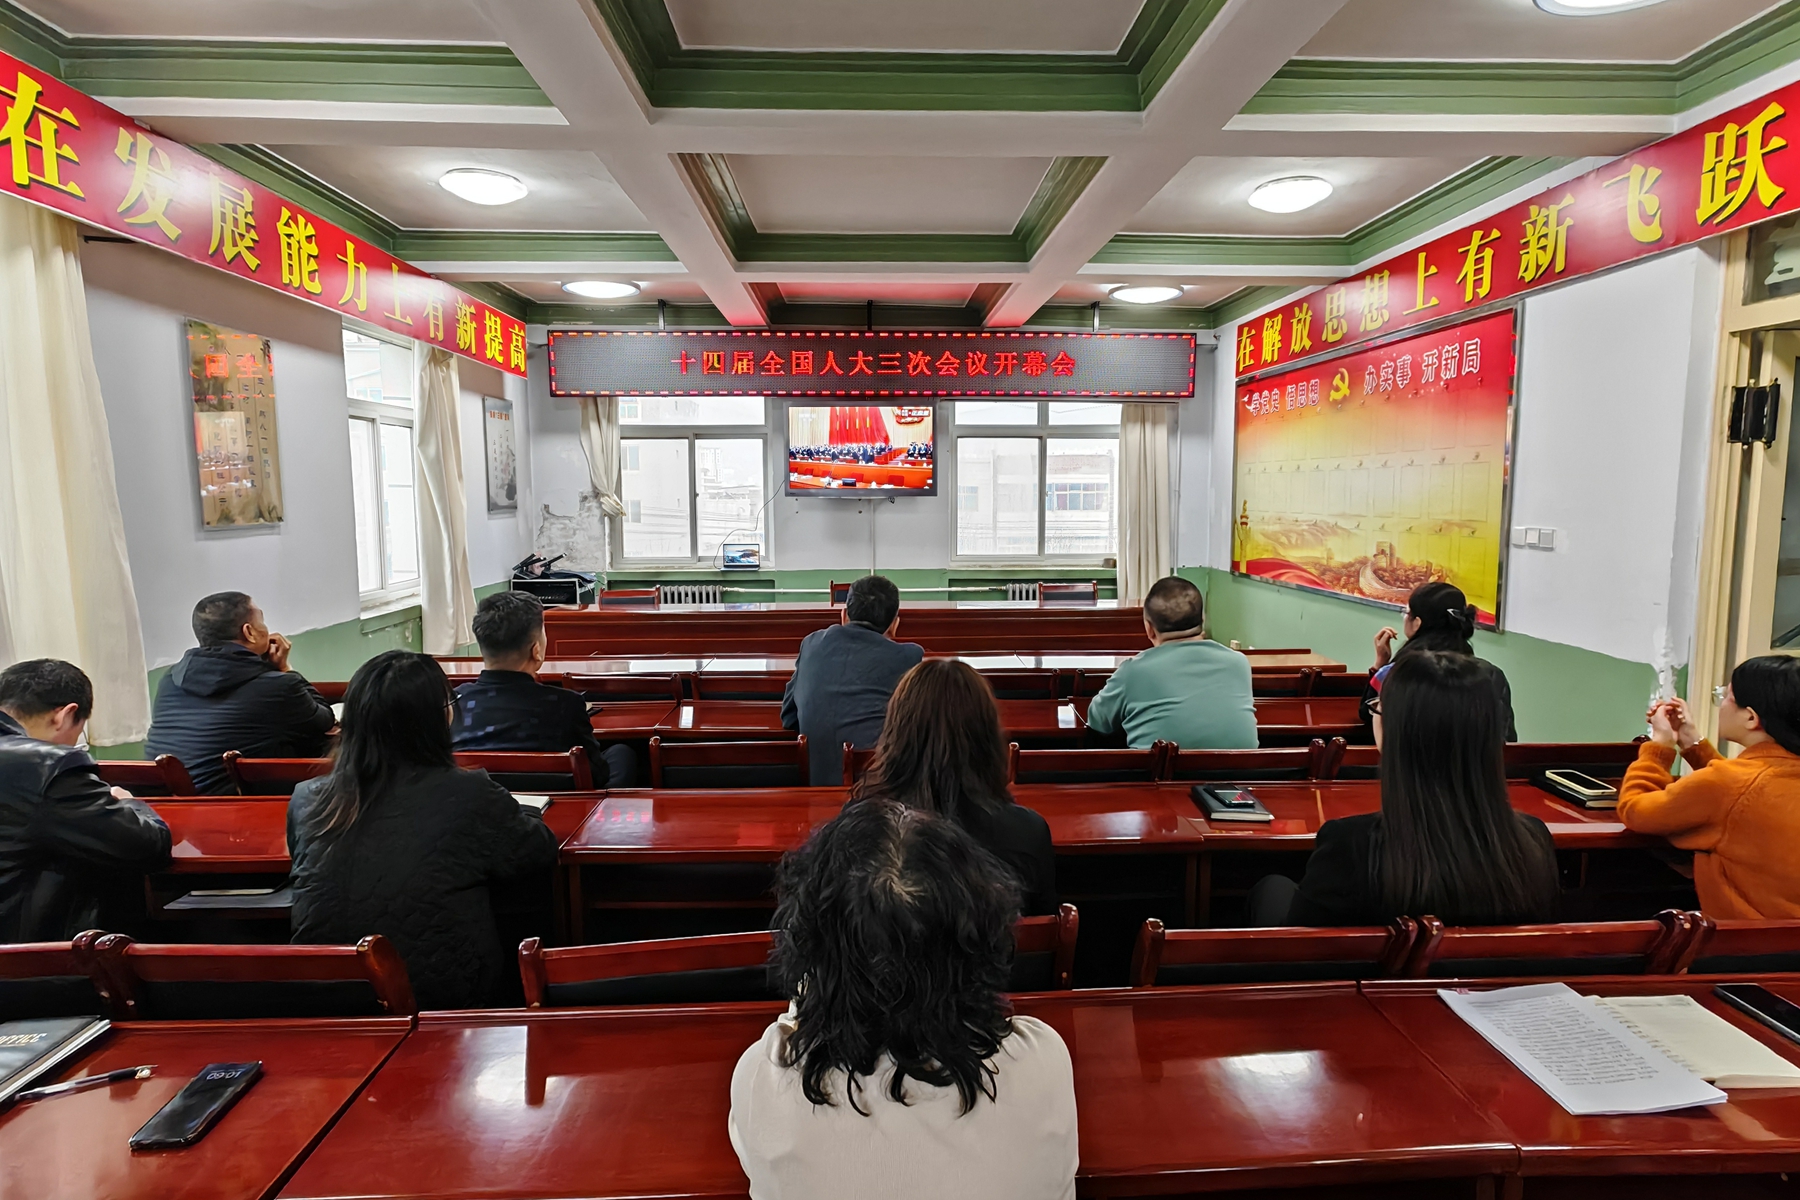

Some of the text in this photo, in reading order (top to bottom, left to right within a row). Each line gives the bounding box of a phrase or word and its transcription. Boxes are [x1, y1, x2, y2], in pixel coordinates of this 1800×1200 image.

[0, 72, 525, 373] 在发展能力上有新提高
[1237, 102, 1787, 371] 在解放思想上有新飞跃
[671, 350, 1076, 376] 十四届全国人大三次会议开幕会
[1251, 388, 1280, 416] 学党史
[1364, 355, 1412, 395] 办实事
[1421, 338, 1481, 383] 开新局
